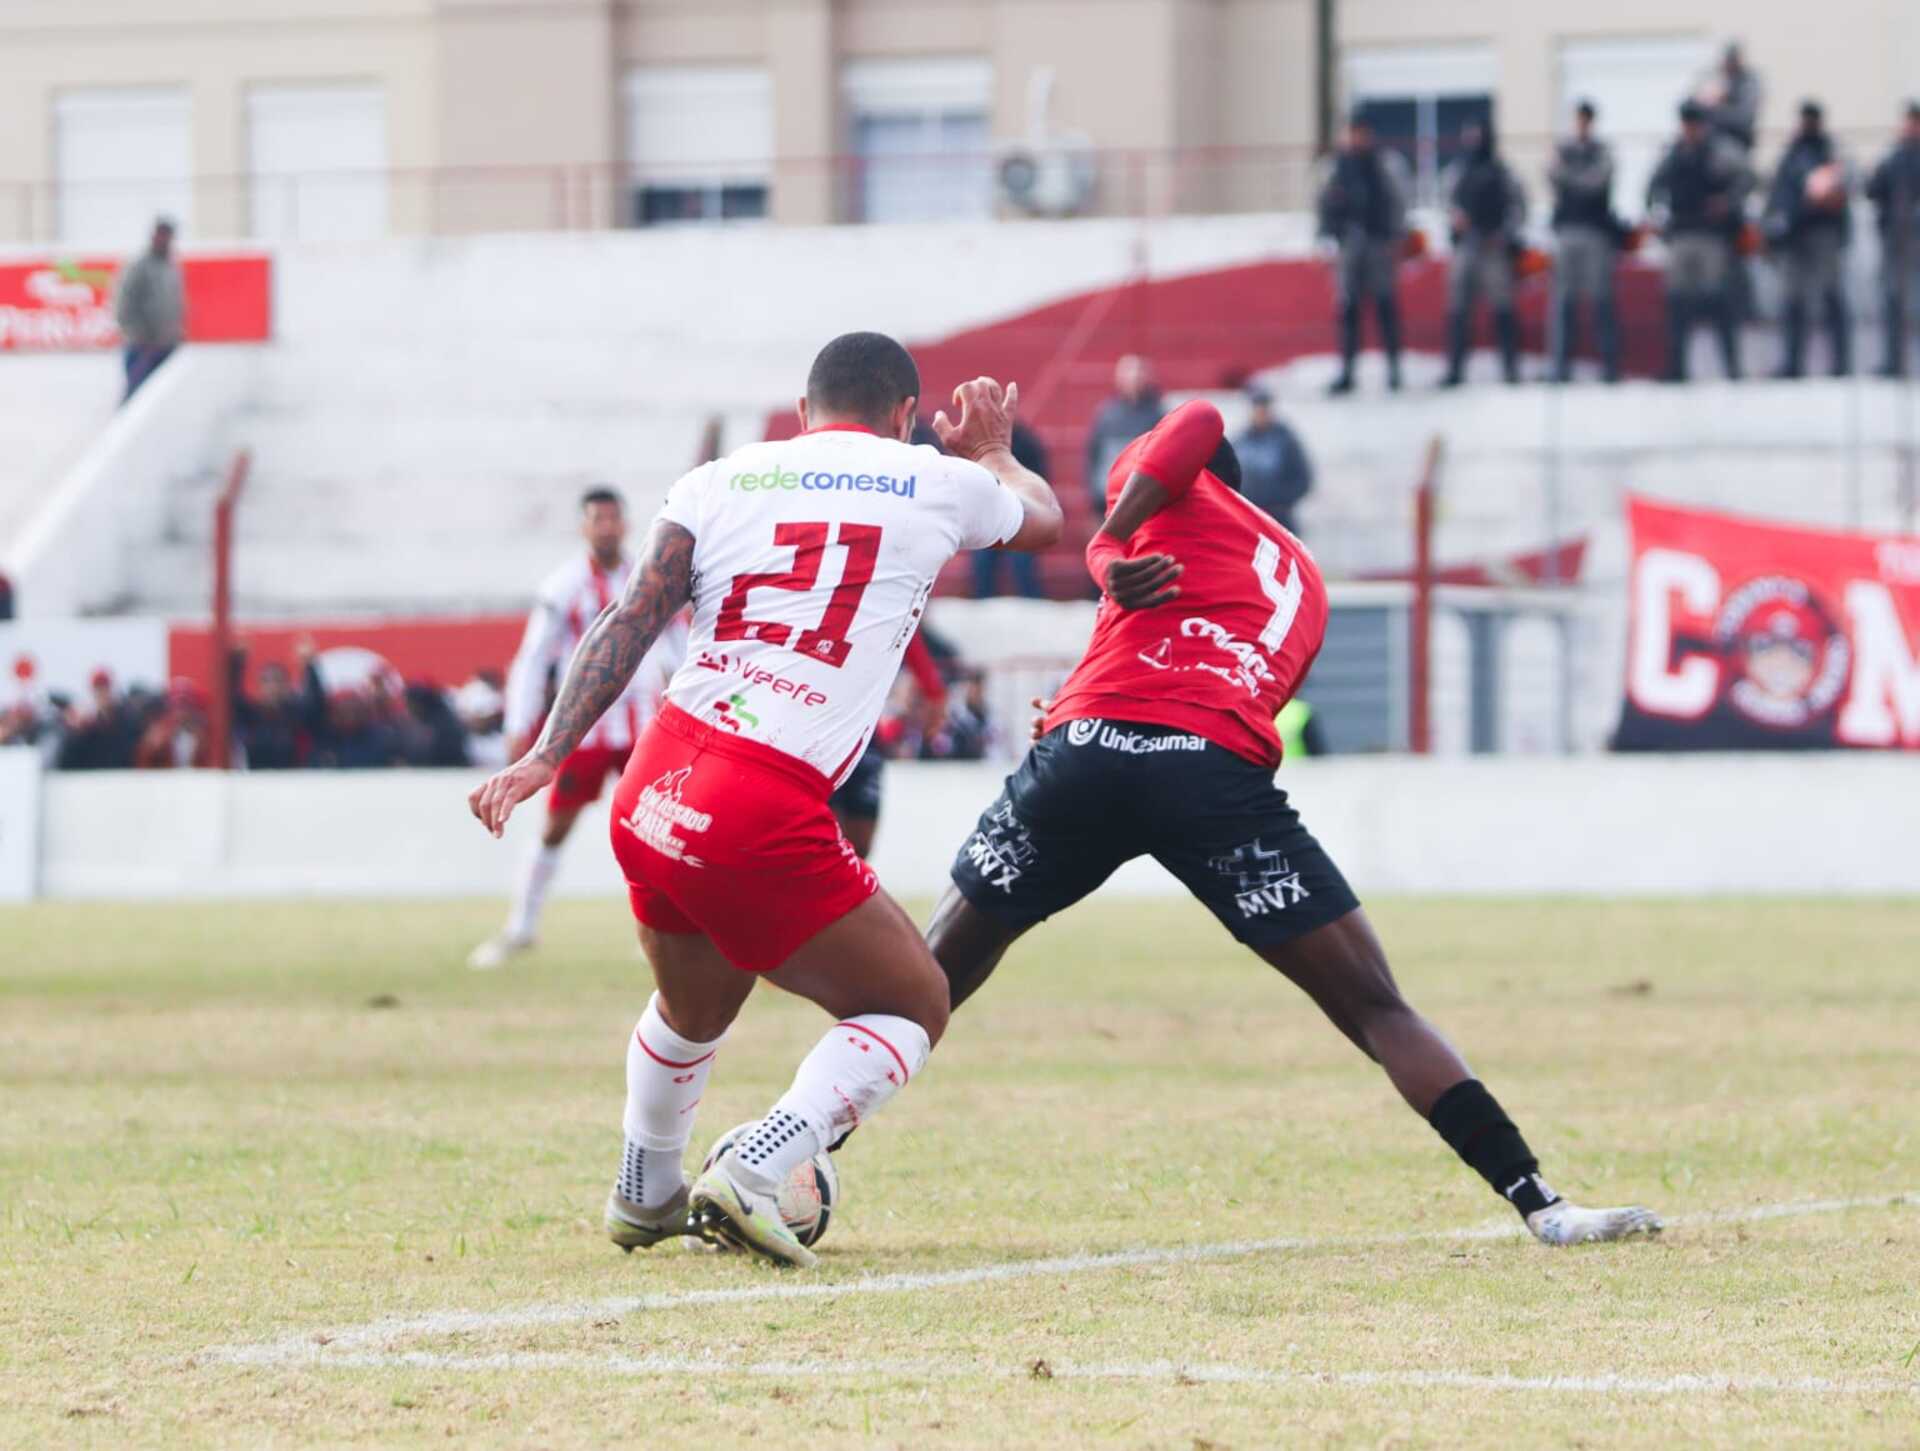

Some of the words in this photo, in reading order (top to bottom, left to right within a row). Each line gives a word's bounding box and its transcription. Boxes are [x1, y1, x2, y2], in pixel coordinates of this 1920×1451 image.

[714, 522, 882, 668] 21
[1252, 533, 1303, 655] 4
[1237, 876, 1310, 918] MVX
